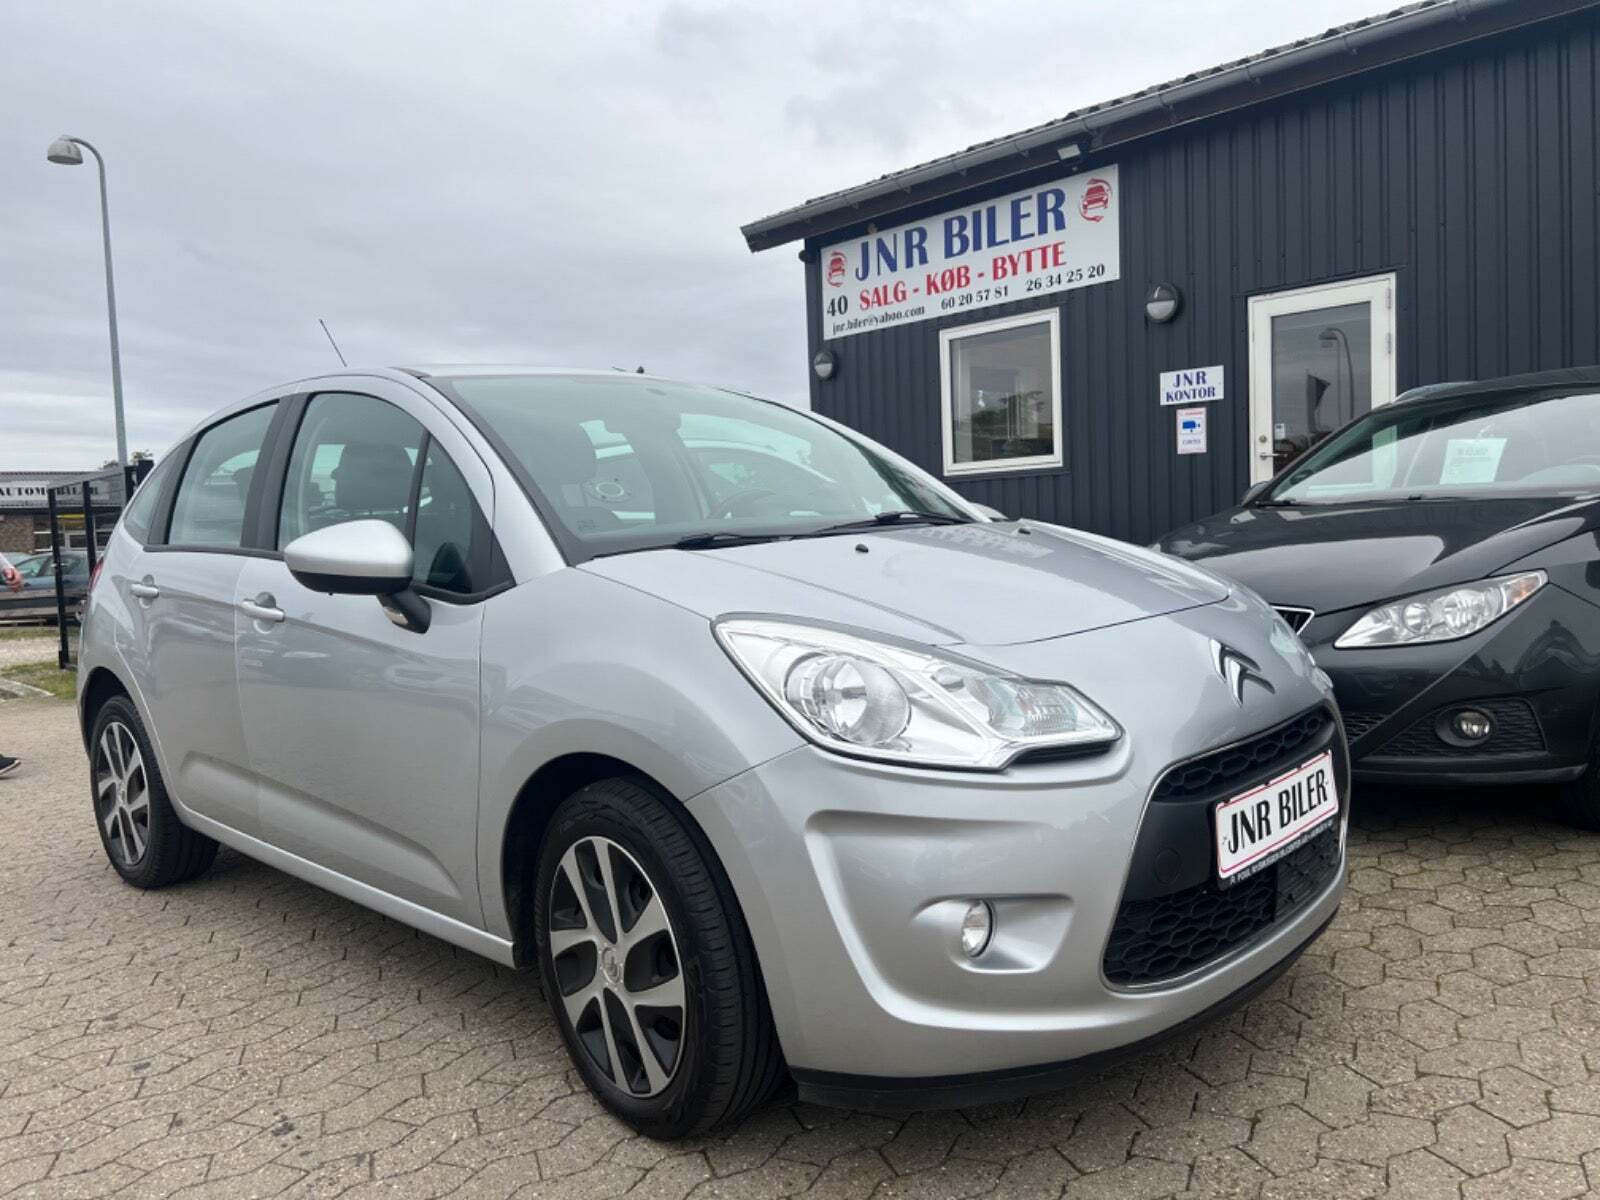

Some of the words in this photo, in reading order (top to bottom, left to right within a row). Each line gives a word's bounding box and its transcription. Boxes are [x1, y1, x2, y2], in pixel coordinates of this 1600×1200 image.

[855, 226, 929, 282] JNR
[943, 188, 1066, 260] BILER
[859, 280, 907, 311] SALG
[926, 265, 971, 296] KØB
[992, 241, 1067, 281] BYTTE
[1026, 278, 1043, 292] 26
[1046, 273, 1062, 288] 34
[1067, 269, 1083, 284] 25
[1088, 264, 1106, 279] 20
[826, 294, 849, 317] 40
[941, 297, 956, 310] 60
[959, 292, 974, 306] 20
[976, 289, 991, 302] 57
[995, 286, 1009, 299] 81
[1173, 370, 1208, 389] JNR
[1165, 386, 1216, 403] KONTOR
[1228, 799, 1272, 854] JNR
[1278, 768, 1328, 829] BILER
